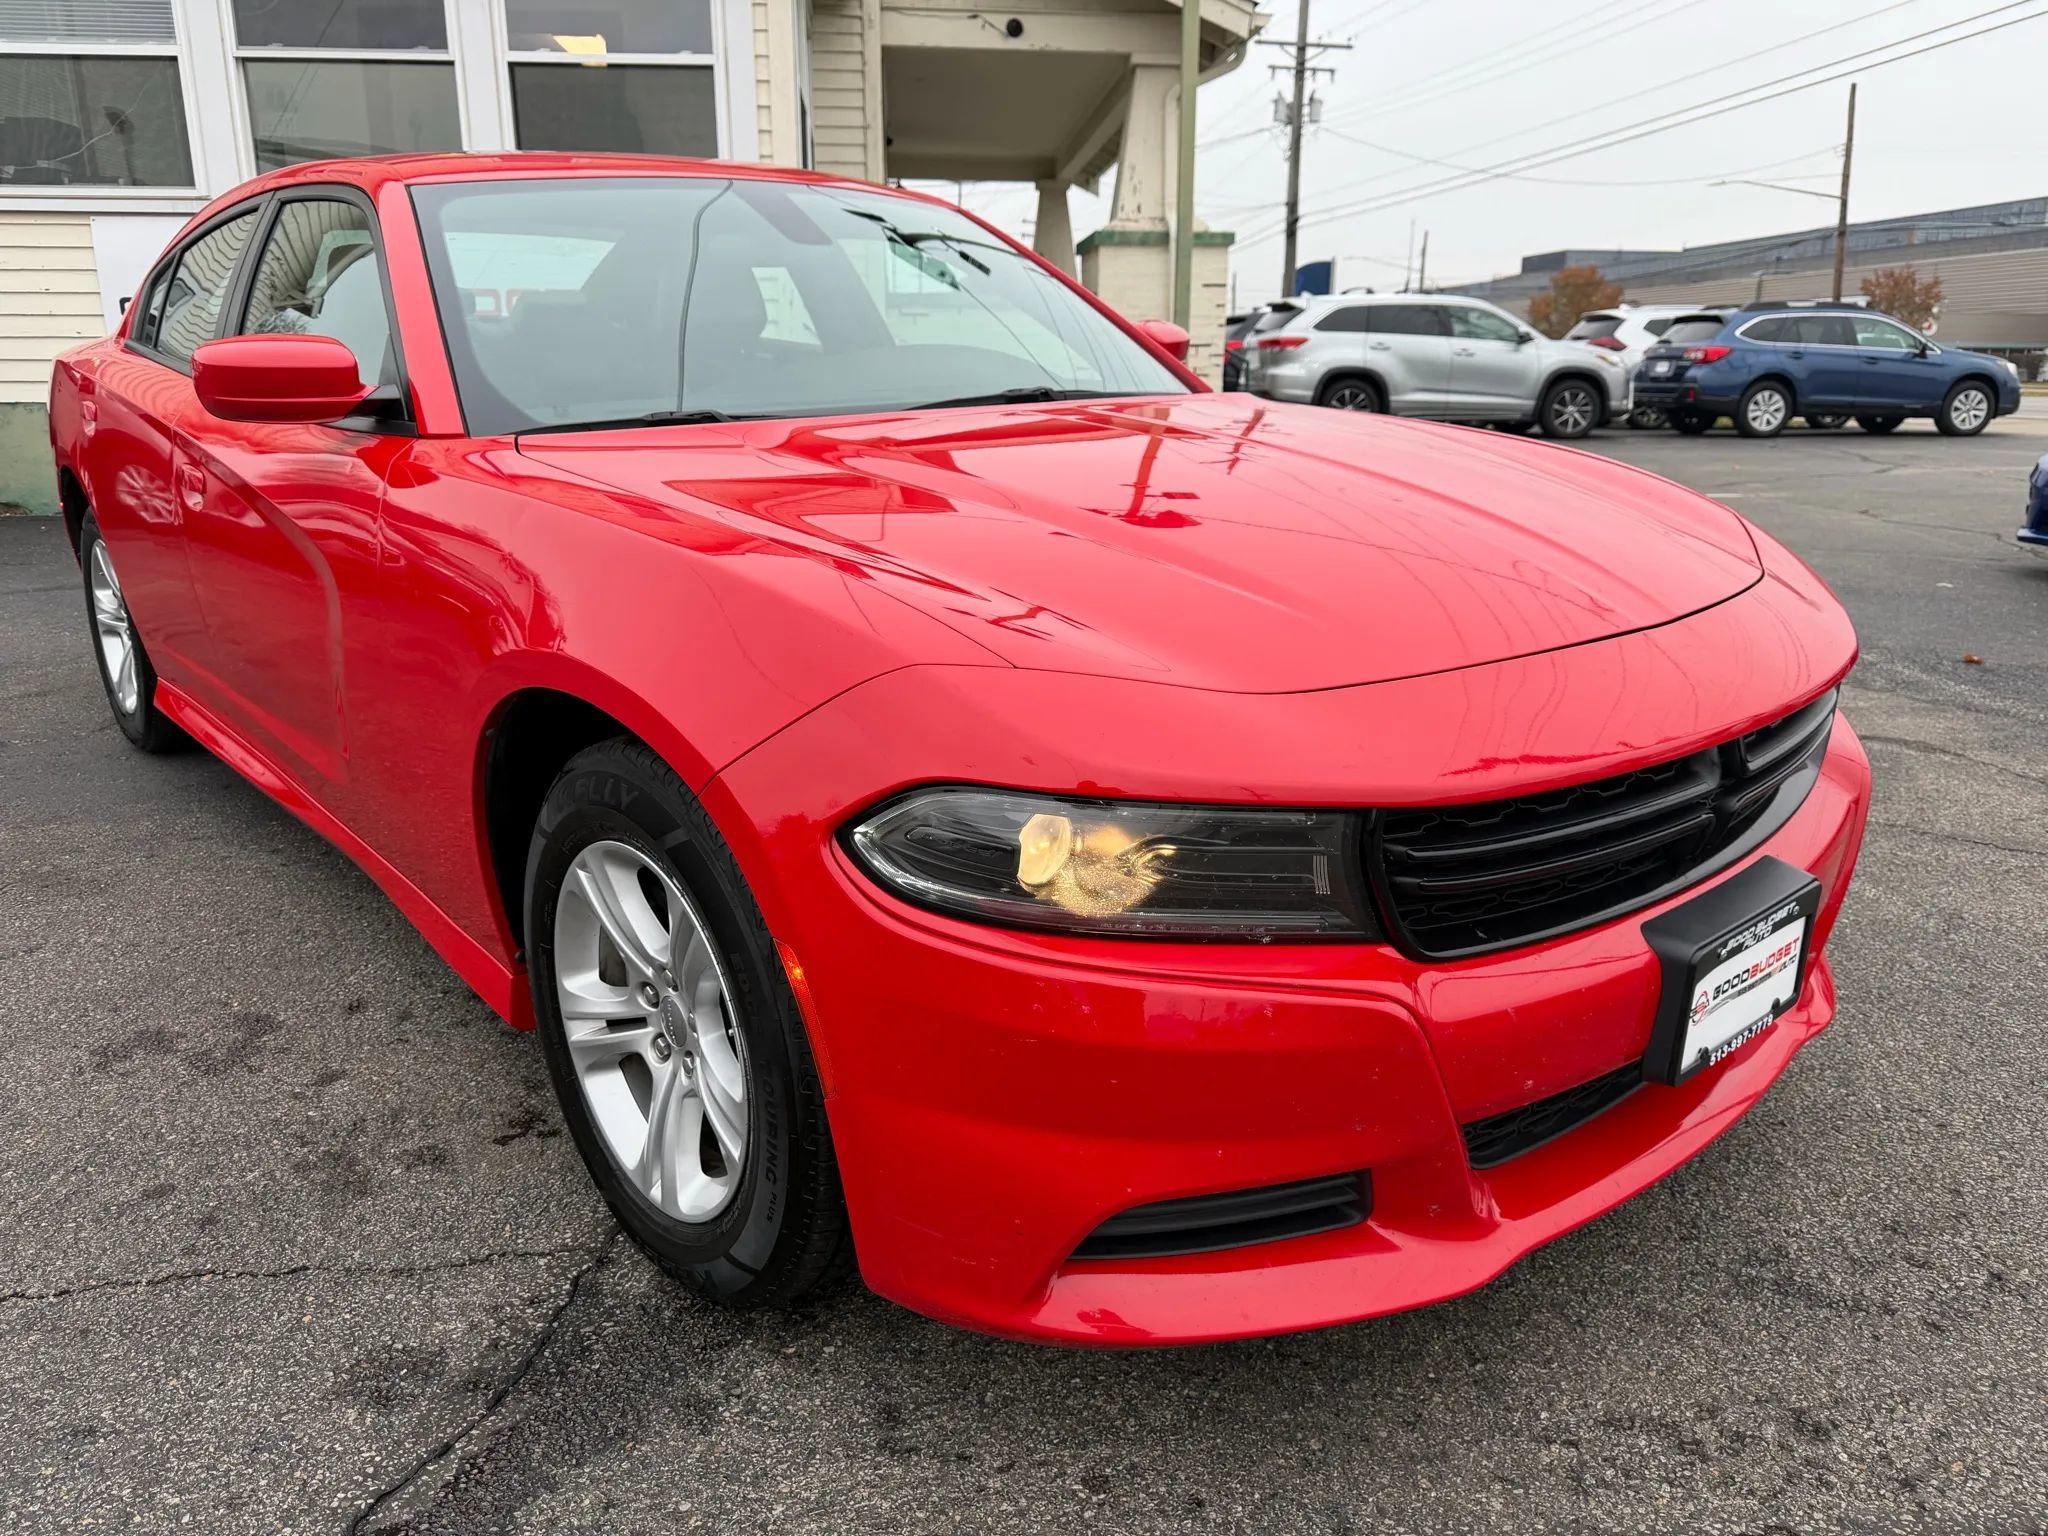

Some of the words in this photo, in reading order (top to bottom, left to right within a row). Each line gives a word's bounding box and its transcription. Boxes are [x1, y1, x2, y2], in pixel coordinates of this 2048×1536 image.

[1755, 901, 1797, 934] BUDGET
[1742, 925, 1773, 950] AUTO
[1709, 1013, 1773, 1067] 513-997-7779
[767, 1192, 777, 1225] PLUS
